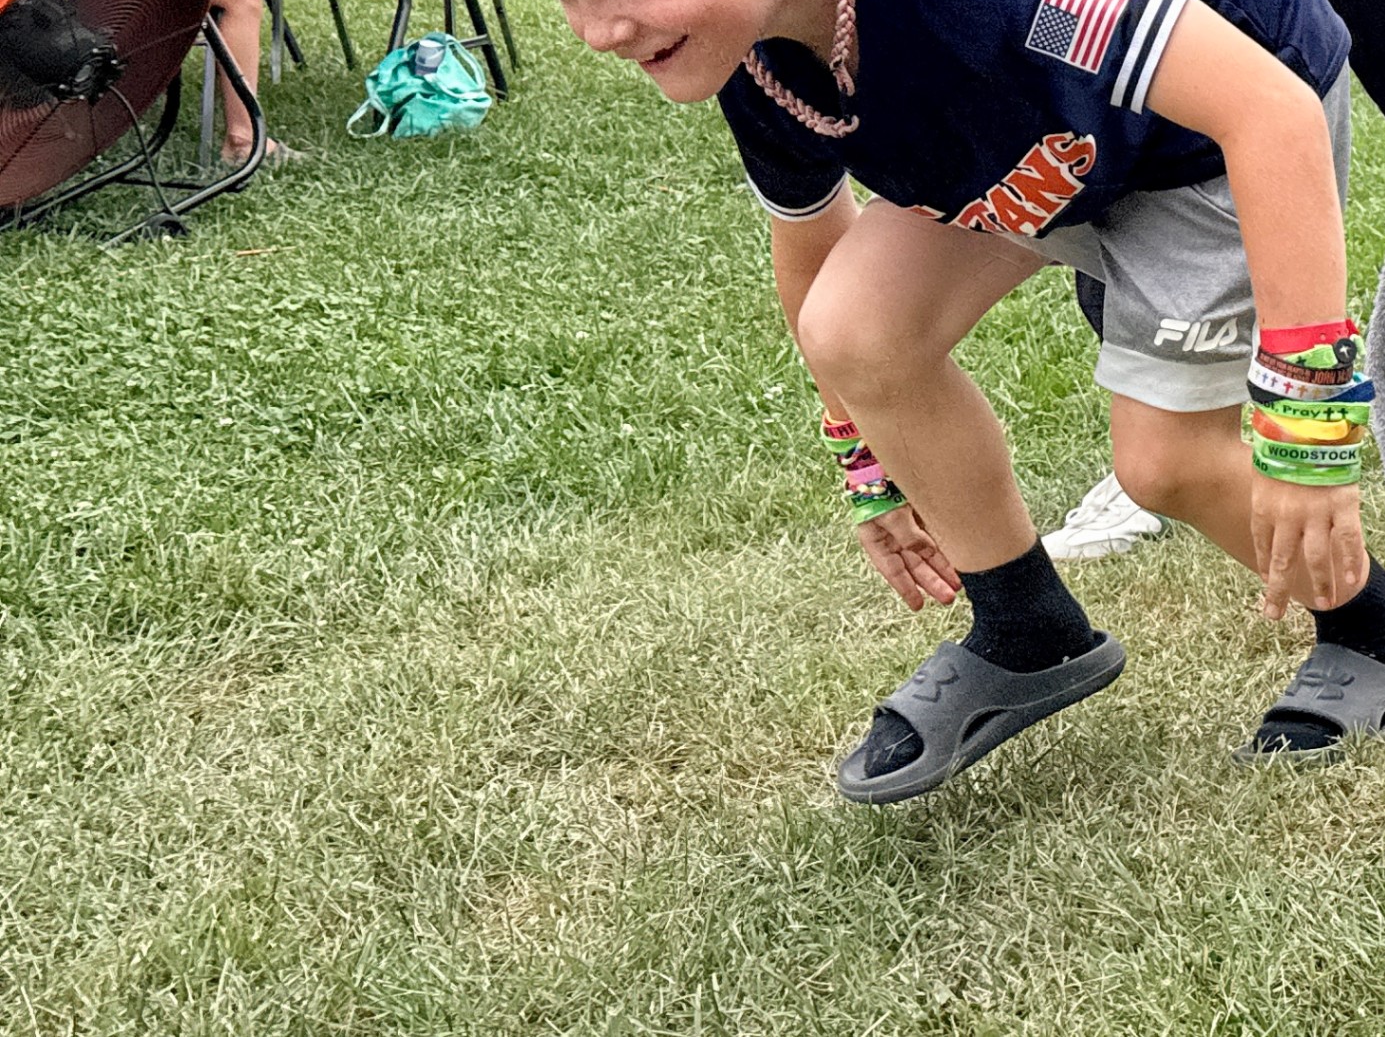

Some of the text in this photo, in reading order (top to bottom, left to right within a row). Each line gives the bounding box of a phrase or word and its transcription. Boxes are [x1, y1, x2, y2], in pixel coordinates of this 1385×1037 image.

[1153, 317, 1239, 352] FILA
[1283, 405, 1321, 419] Pray
[1268, 446, 1357, 460] WOODSTOCK
